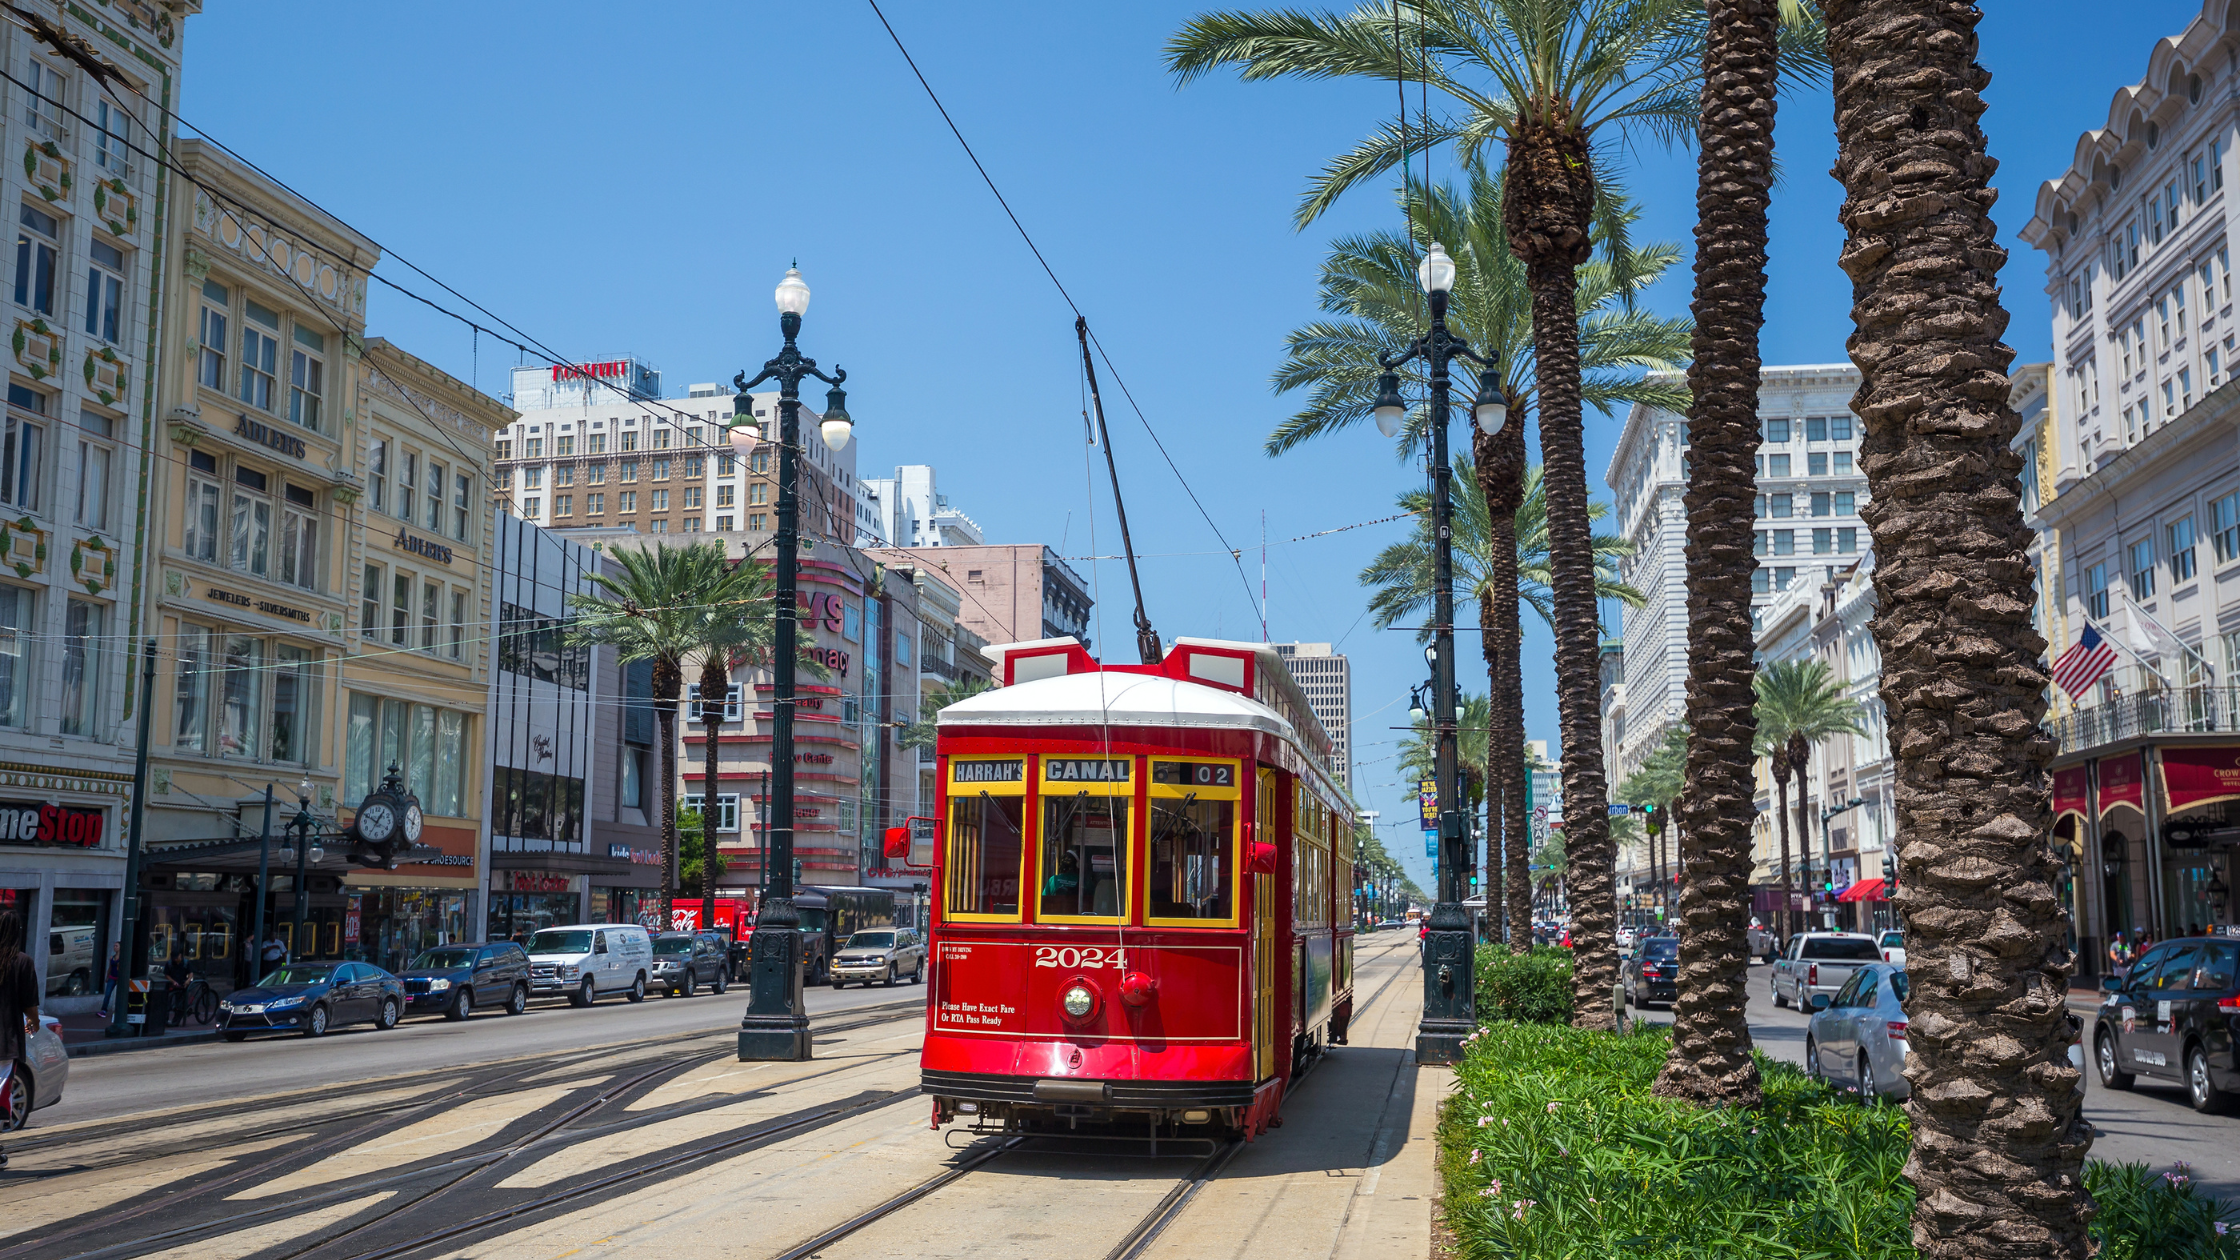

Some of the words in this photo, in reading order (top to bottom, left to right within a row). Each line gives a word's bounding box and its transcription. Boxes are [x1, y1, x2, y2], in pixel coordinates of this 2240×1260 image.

[552, 361, 626, 381] ROOSEVELT
[234, 413, 306, 459] ADLER'S
[394, 527, 453, 564] ADLER'S
[207, 588, 251, 607] JEWELERS
[259, 601, 310, 622] SILVERSMITHS
[795, 698, 824, 709] eauty
[805, 752, 834, 764] Center
[956, 762, 1023, 781] HARRAH'S
[1047, 761, 1129, 780] CANAL
[793, 806, 820, 817] iquor
[538, 872, 570, 892] Locker
[1035, 947, 1128, 969] 2024
[942, 1001, 960, 1011] Please
[962, 1002, 978, 1012] Have
[979, 1003, 998, 1013] Exact
[1000, 1004, 1015, 1014] Fare
[941, 1012, 949, 1022] Or
[951, 1013, 964, 1023] RTA
[966, 1014, 980, 1024] Pass
[982, 1015, 1002, 1026] Ready
